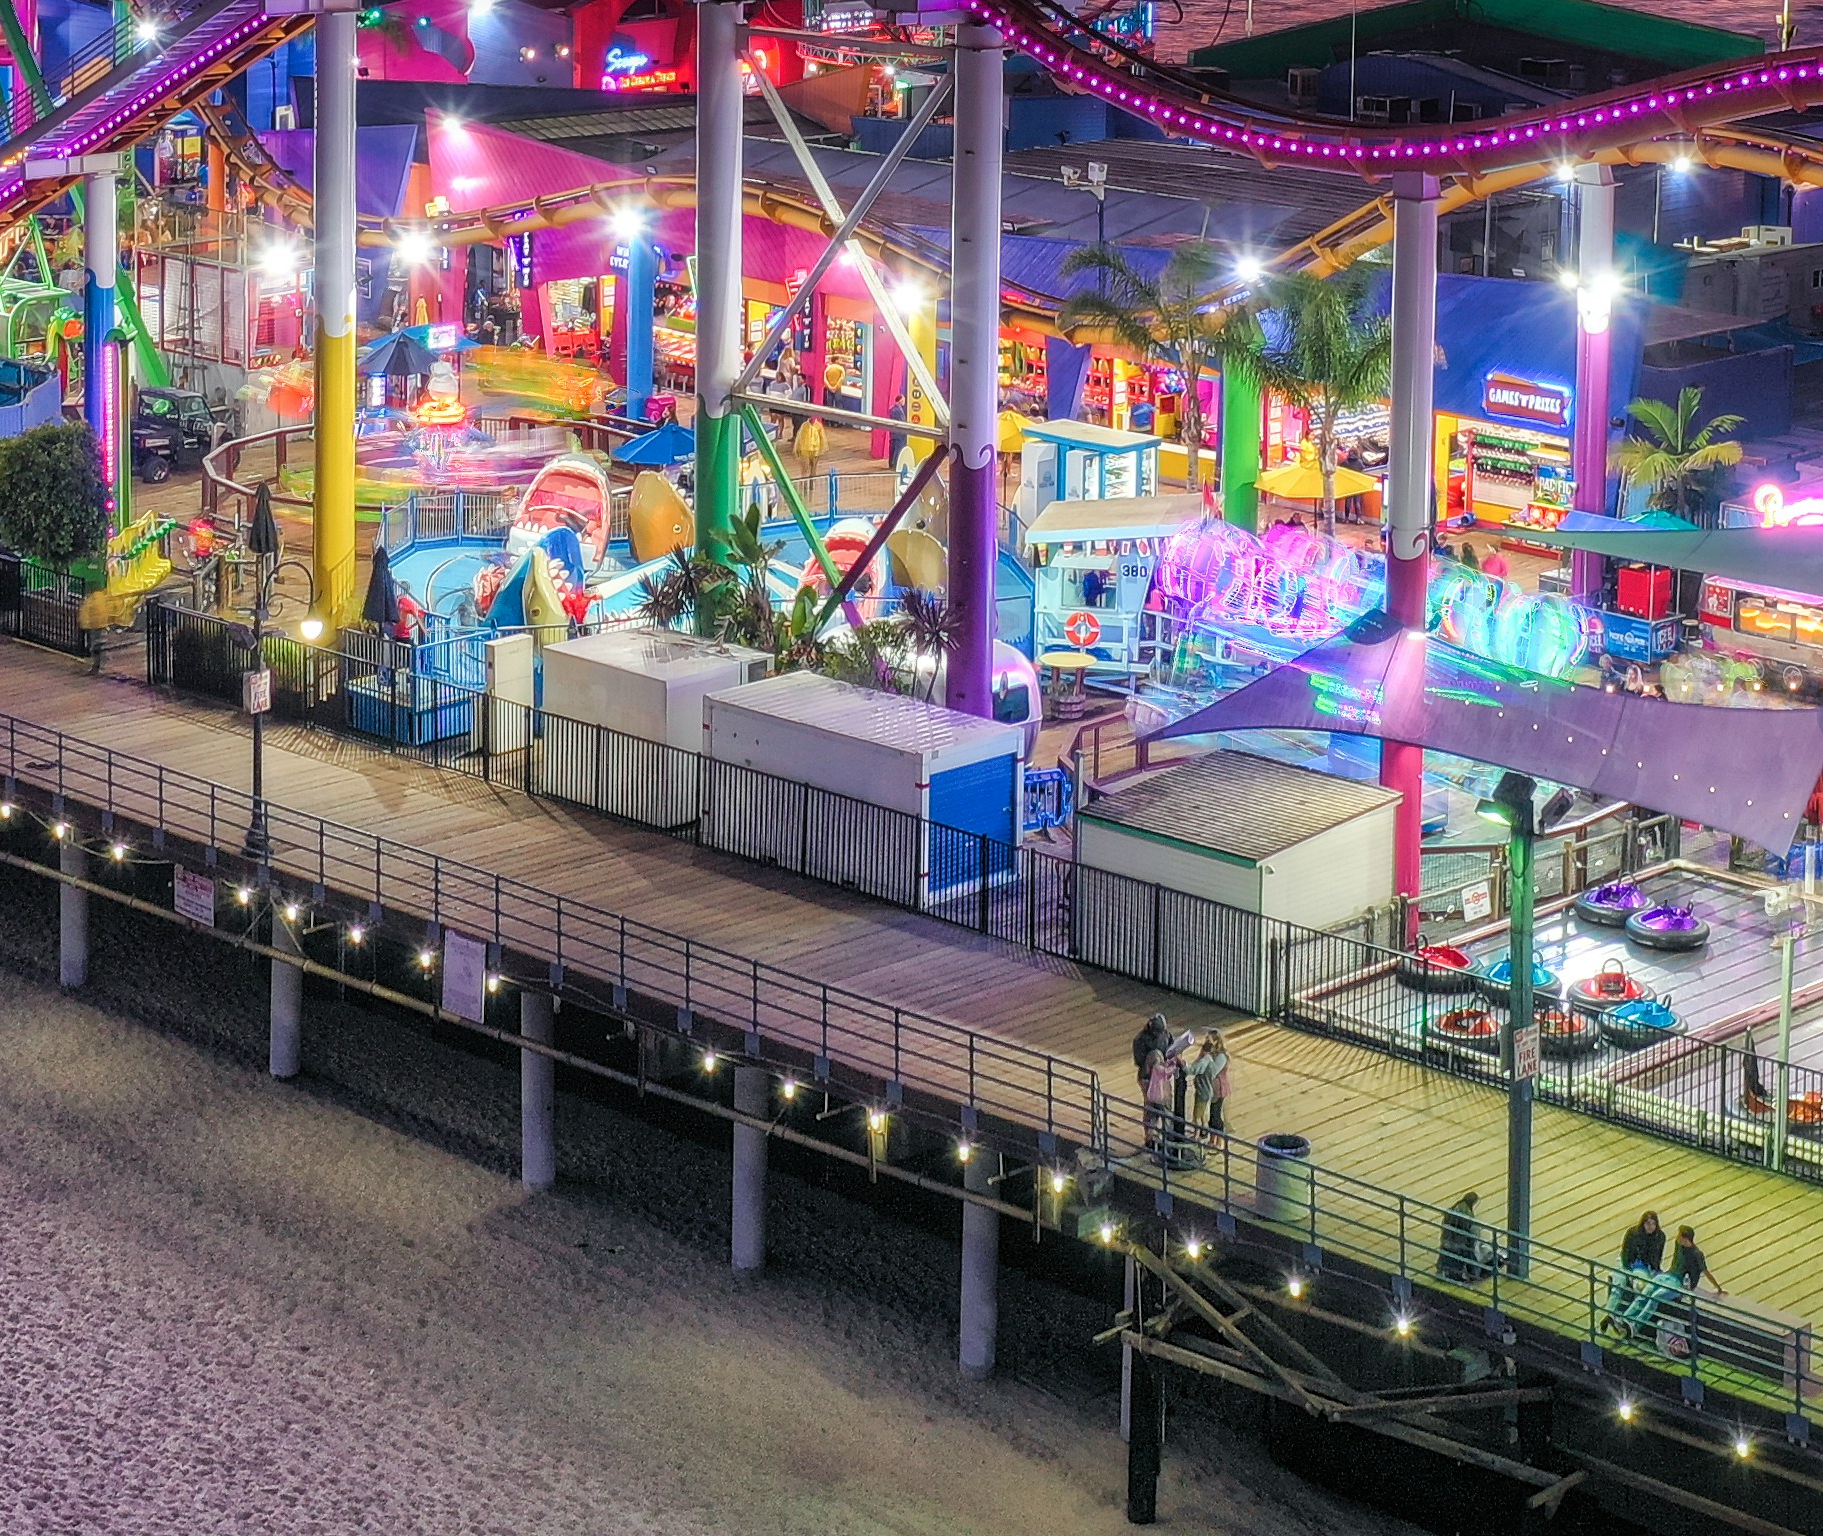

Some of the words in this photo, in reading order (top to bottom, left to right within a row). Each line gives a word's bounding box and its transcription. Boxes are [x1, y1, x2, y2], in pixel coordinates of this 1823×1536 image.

[1489, 388, 1520, 407] GAMES
[1528, 394, 1562, 414] PRIZES
[1122, 565, 1148, 578] 380
[1518, 1047, 1536, 1064] FIRE
[1517, 1059, 1537, 1077] LANE
